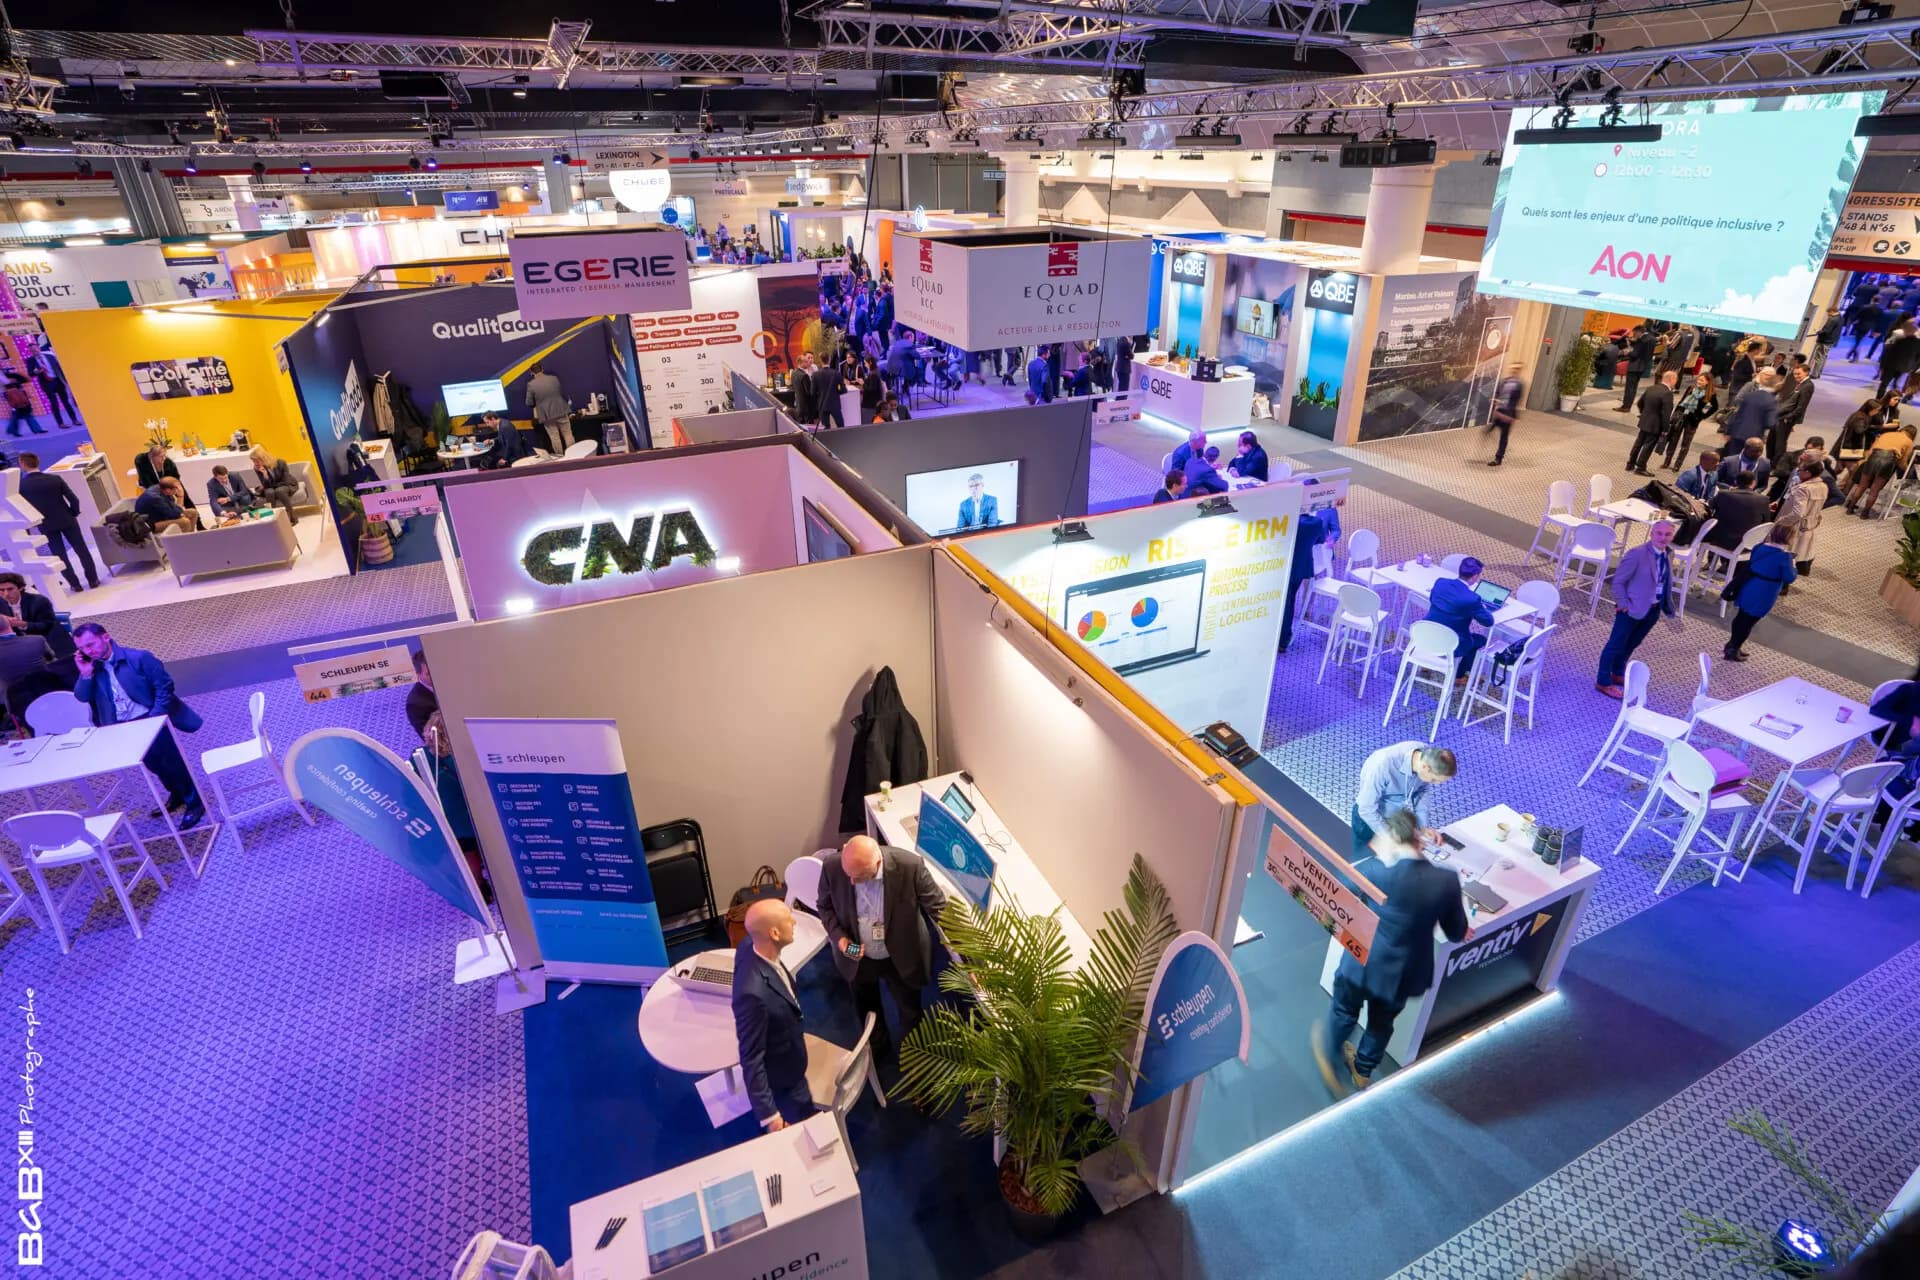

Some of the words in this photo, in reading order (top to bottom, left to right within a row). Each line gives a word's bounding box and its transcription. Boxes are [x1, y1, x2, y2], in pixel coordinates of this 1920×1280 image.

[1662, 119, 1700, 136] ORA
[595, 151, 640, 160] LEXINGTON
[1847, 195, 1920, 207] GRESSISTE
[1521, 206, 1549, 218] Quels
[1550, 209, 1572, 219] sont
[1574, 210, 1588, 220] les
[1590, 211, 1625, 224] enjeux
[1628, 213, 1659, 225] d'une
[1661, 214, 1714, 230] politique
[1716, 217, 1772, 232] inclusive
[1777, 220, 1785, 232] ?
[1840, 221, 1858, 231] °48
[1847, 212, 1889, 222] STANDS
[522, 255, 677, 285] EGERIE
[1183, 258, 1205, 278] QBE
[1589, 244, 1672, 284] AON
[15, 285, 72, 299] ODUCT
[526, 286, 576, 295] INTEGRATED
[624, 279, 677, 288] MANAGEMENT
[911, 275, 943, 296] EQUAD
[1023, 282, 1099, 303] EQUAD
[1324, 281, 1356, 304] QBE
[1046, 303, 1076, 315] RCC
[998, 327, 1033, 336] ACTEUR
[1038, 325, 1049, 333] DE
[1052, 323, 1063, 332] LA
[661, 356, 672, 364] 03
[149, 361, 228, 381] Collomé
[700, 377, 715, 385] 300
[1150, 377, 1173, 399] QBE
[379, 498, 397, 506] CNA
[397, 494, 422, 504] HARDY
[1246, 514, 1290, 543] IRM
[520, 506, 717, 586] CNA
[1211, 557, 1285, 583] AUTOMATISATION
[1208, 578, 1249, 597] PROCESS
[1221, 590, 1282, 612] CENTRALISATION
[1218, 605, 1269, 628] LOGICIEL
[320, 662, 376, 679] SCHLEUPEN
[377, 660, 390, 669] SE
[310, 690, 327, 700] 44
[506, 753, 566, 765] schleupen
[1302, 855, 1339, 895] VENTIV
[1283, 855, 1354, 925] TECHNOLOGY
[1346, 939, 1362, 958] 45
[1447, 920, 1532, 977] ventiv
[1171, 984, 1216, 1027] schleupen
